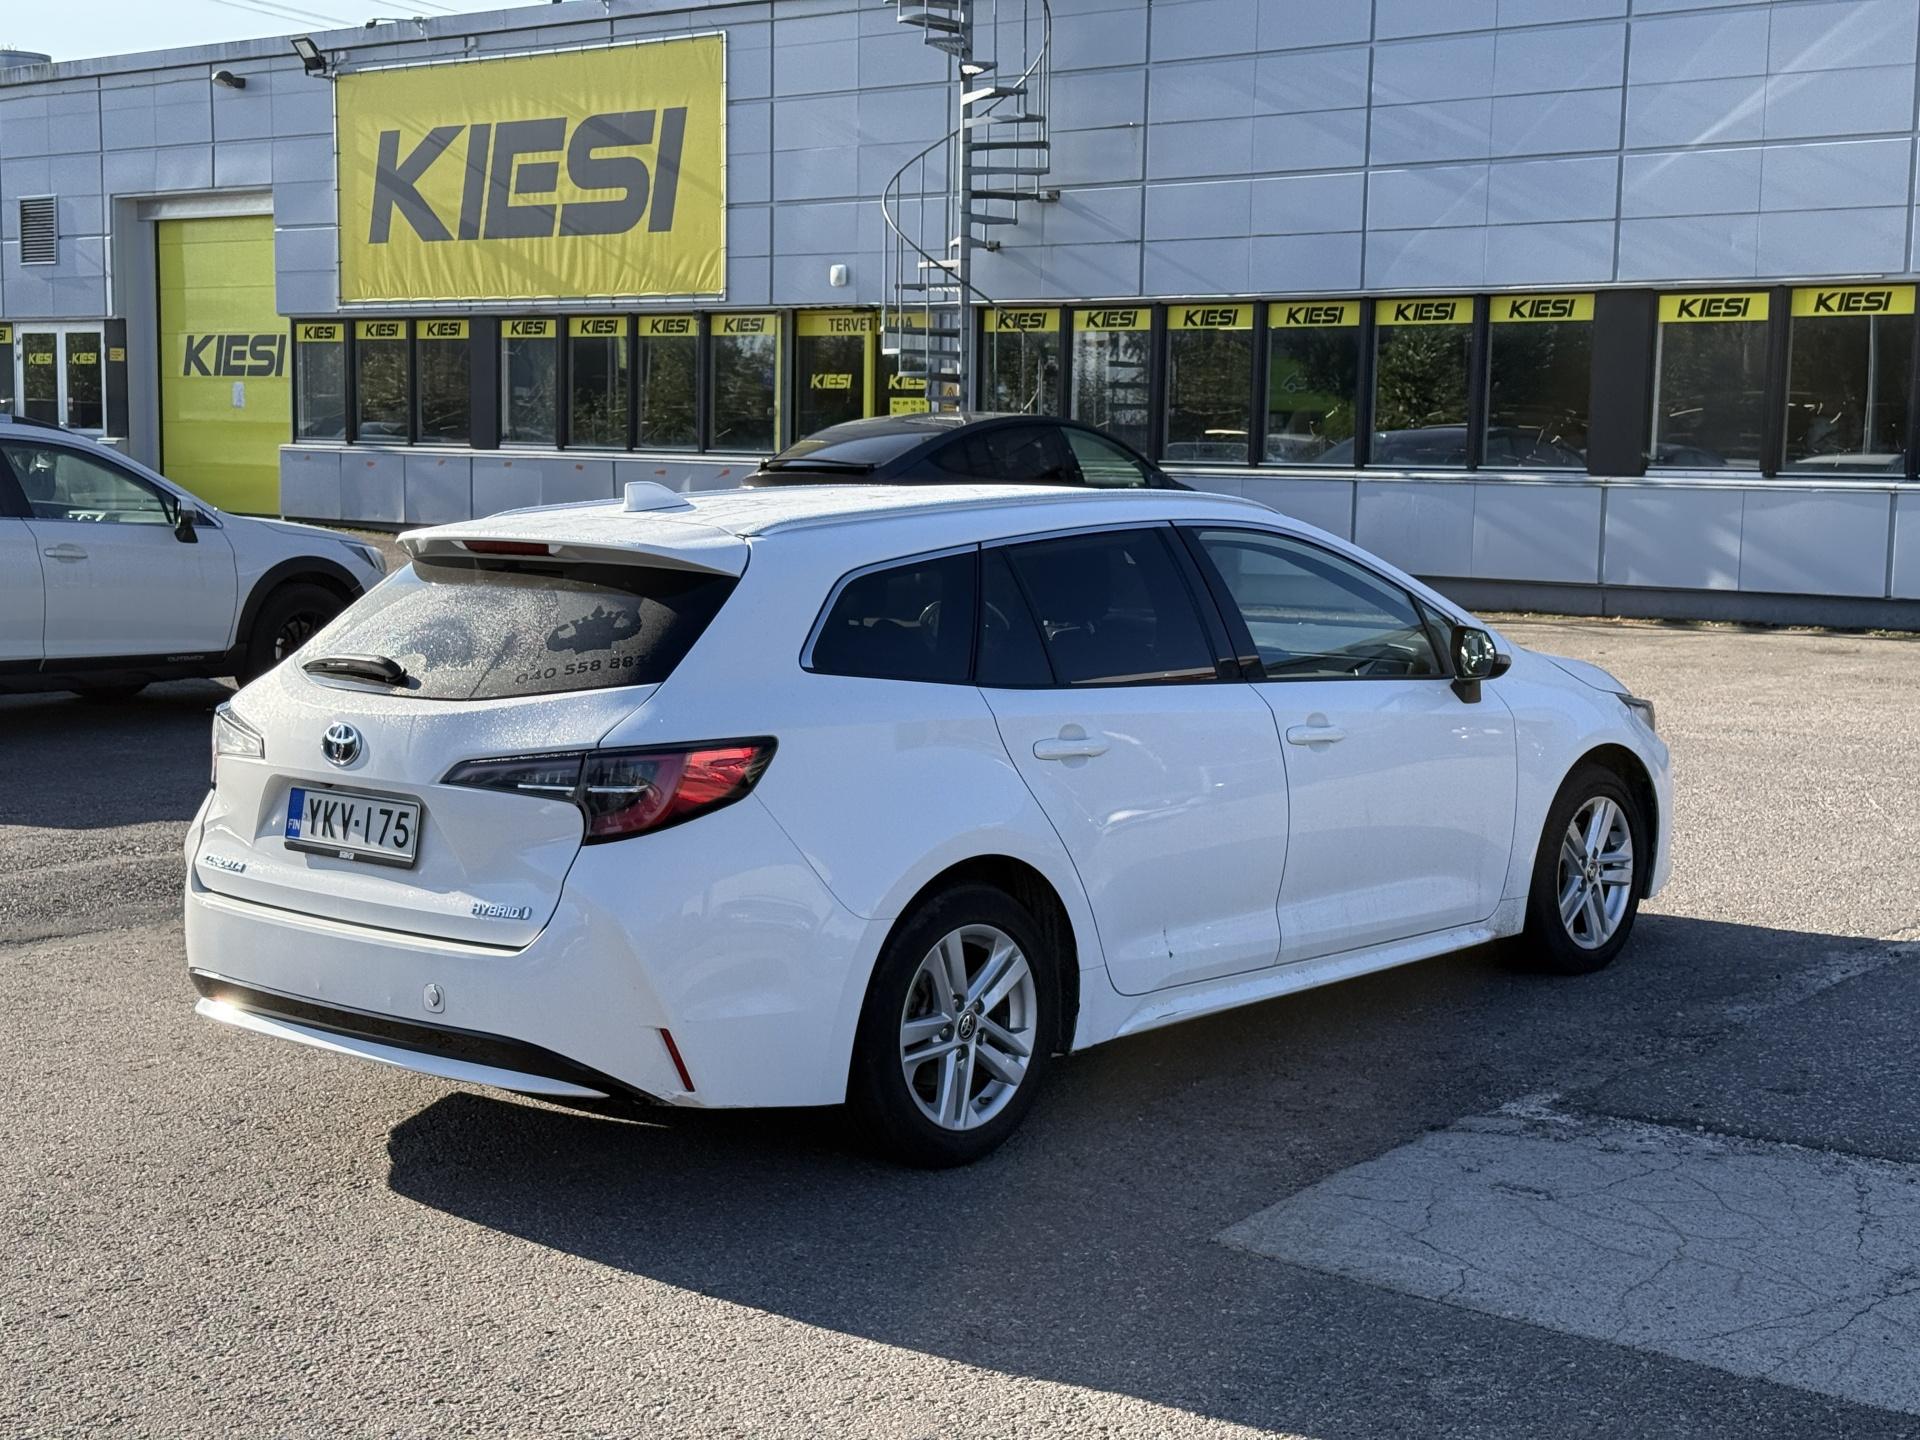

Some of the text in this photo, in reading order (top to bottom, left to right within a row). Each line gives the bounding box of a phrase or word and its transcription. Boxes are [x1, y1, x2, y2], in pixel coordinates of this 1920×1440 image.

[368, 106, 687, 244] KIESI
[1509, 298, 1575, 318] KIESI
[1677, 297, 1750, 318] KIESI
[1815, 291, 1892, 312] KIESI
[998, 311, 1047, 328] KIESI
[1086, 310, 1138, 328] KIESI
[1184, 309, 1238, 326] KIESI
[1286, 306, 1344, 324] KIESI
[1394, 302, 1456, 321] KIESI
[366, 323, 398, 337] KIESI
[427, 322, 461, 336] KIESI
[510, 321, 547, 335] KIESI
[580, 319, 618, 334] KIESI
[650, 319, 690, 334] KIESI
[724, 317, 765, 333] KIESI
[828, 316, 913, 332] TERVETLOA
[304, 326, 336, 339] KIESI
[28, 353, 53, 365] KIESI
[72, 353, 97, 365] KIESI
[184, 335, 287, 377] KIESI
[811, 374, 852, 389] KIESI
[888, 374, 928, 389] KIES
[564, 660, 601, 676] 558
[287, 818, 300, 830] FIN
[309, 798, 411, 849] YKV-175
[472, 903, 521, 919] HYBRID
